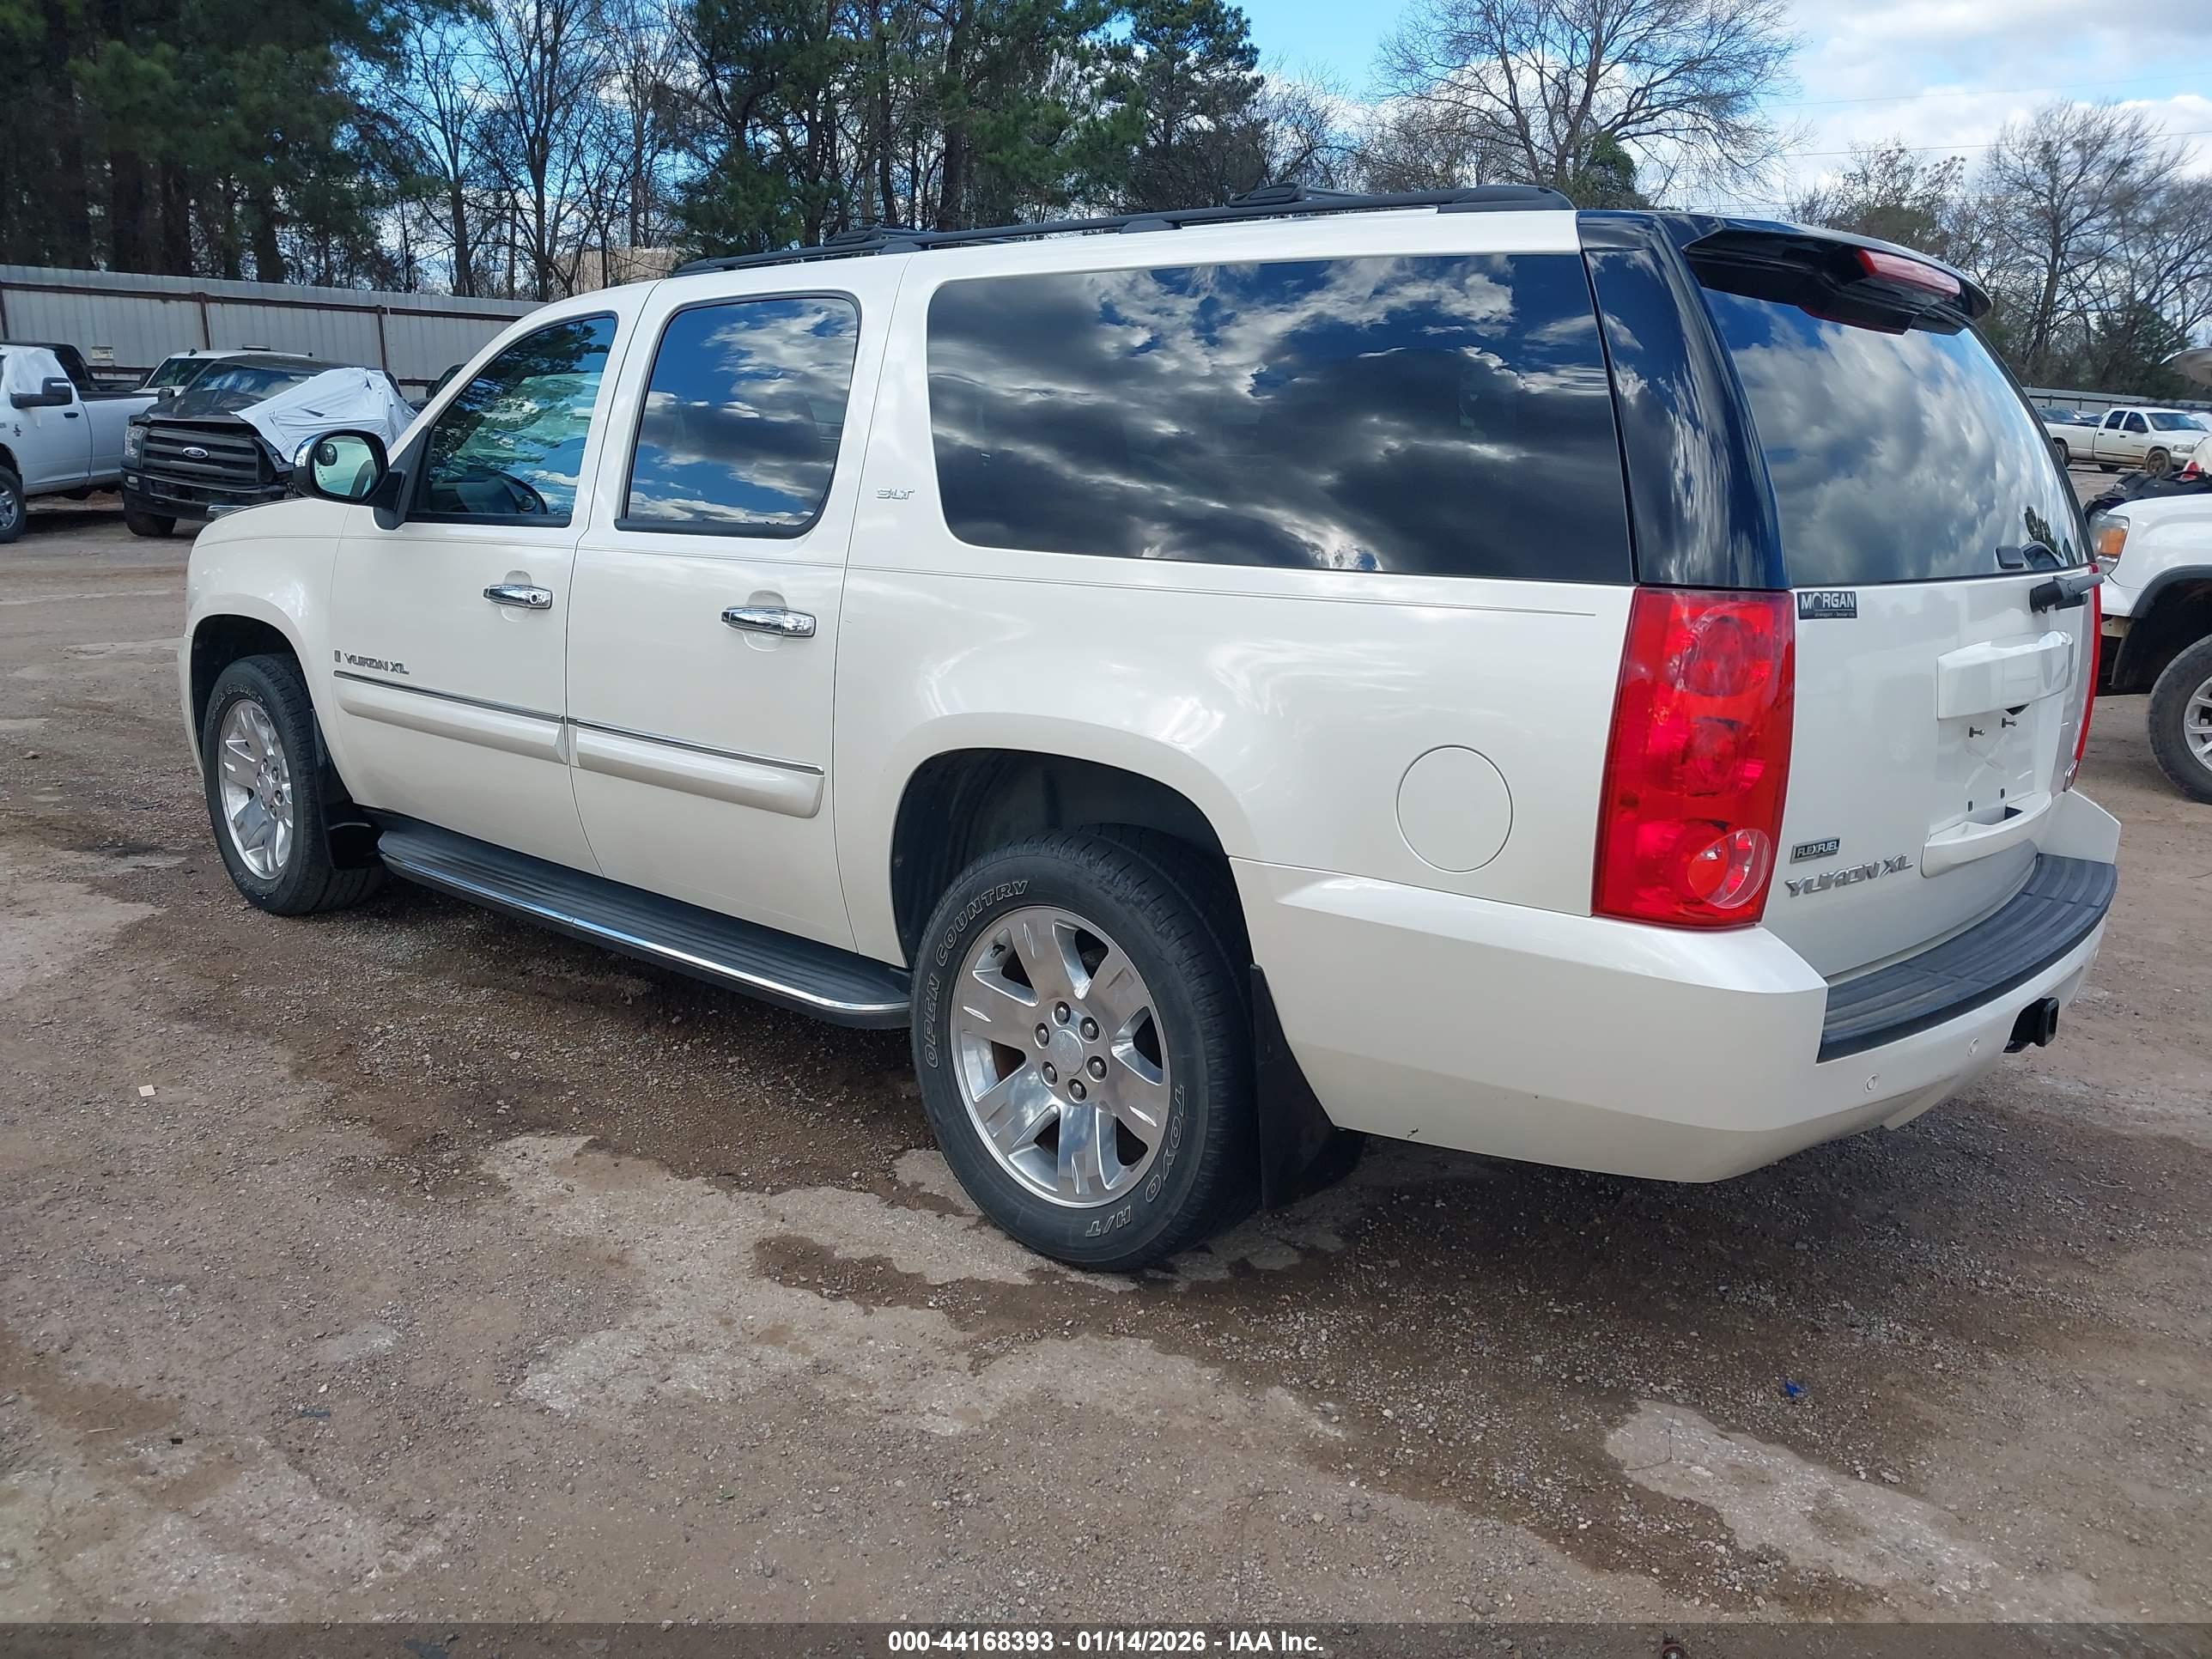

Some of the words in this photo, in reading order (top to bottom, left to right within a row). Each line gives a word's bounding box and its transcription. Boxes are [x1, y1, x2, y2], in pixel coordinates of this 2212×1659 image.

[876, 489, 915, 501] SLT
[1801, 592, 1855, 610] MORGAN
[343, 653, 389, 672] YUKON
[390, 660, 410, 675] XL
[1784, 860, 1881, 898] YUKON
[1880, 854, 1914, 877] XL
[924, 973, 941, 1068] OPEN
[935, 880, 1029, 967] COUNTRY
[1145, 1085, 1186, 1203] TOYO
[1085, 1205, 1132, 1237] H/T
